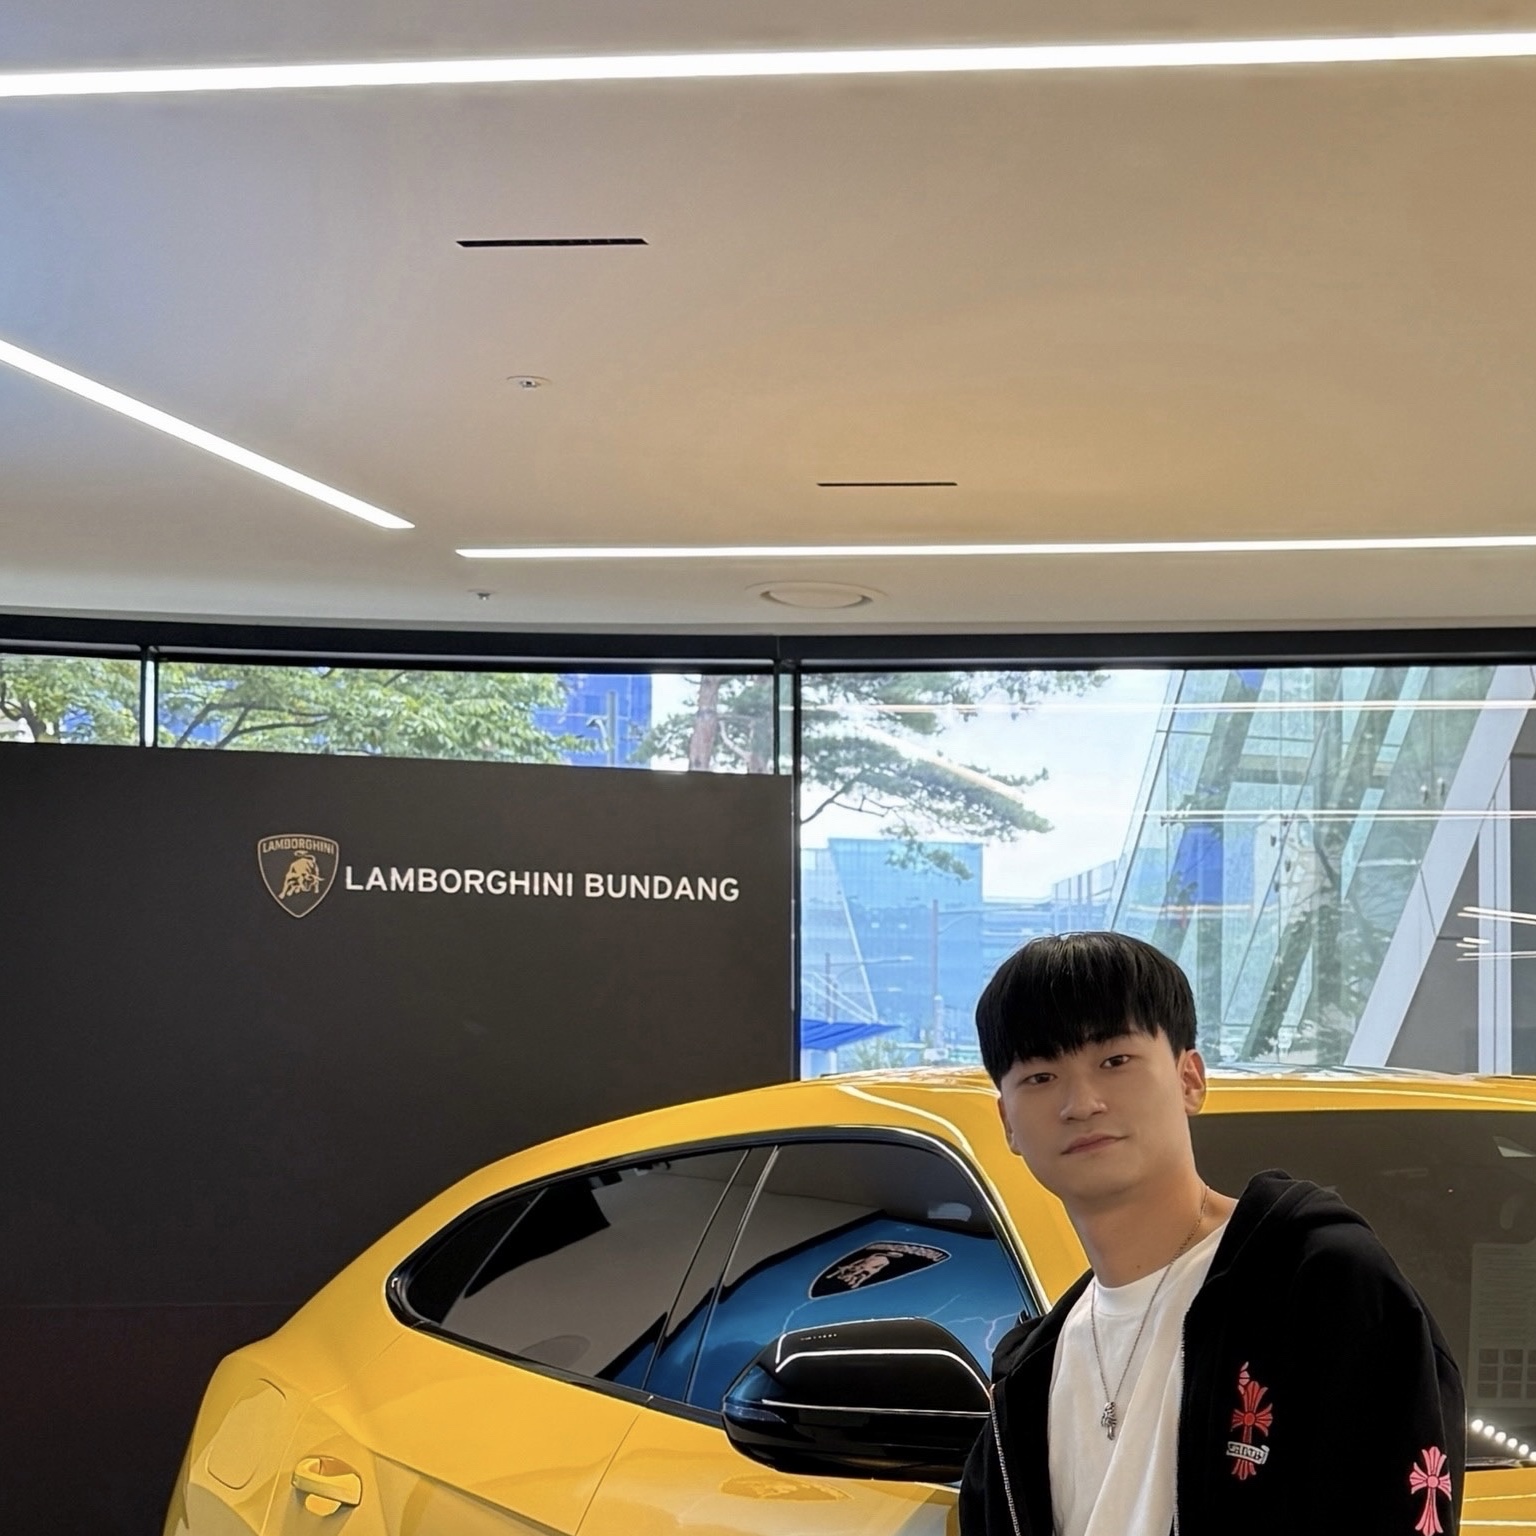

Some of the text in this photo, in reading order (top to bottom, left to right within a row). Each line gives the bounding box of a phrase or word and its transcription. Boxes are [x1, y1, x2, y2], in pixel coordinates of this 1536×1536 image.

[262, 837, 335, 855] LAMBORGHINI
[345, 865, 740, 902] LAMBORGHINI BUNDANG
